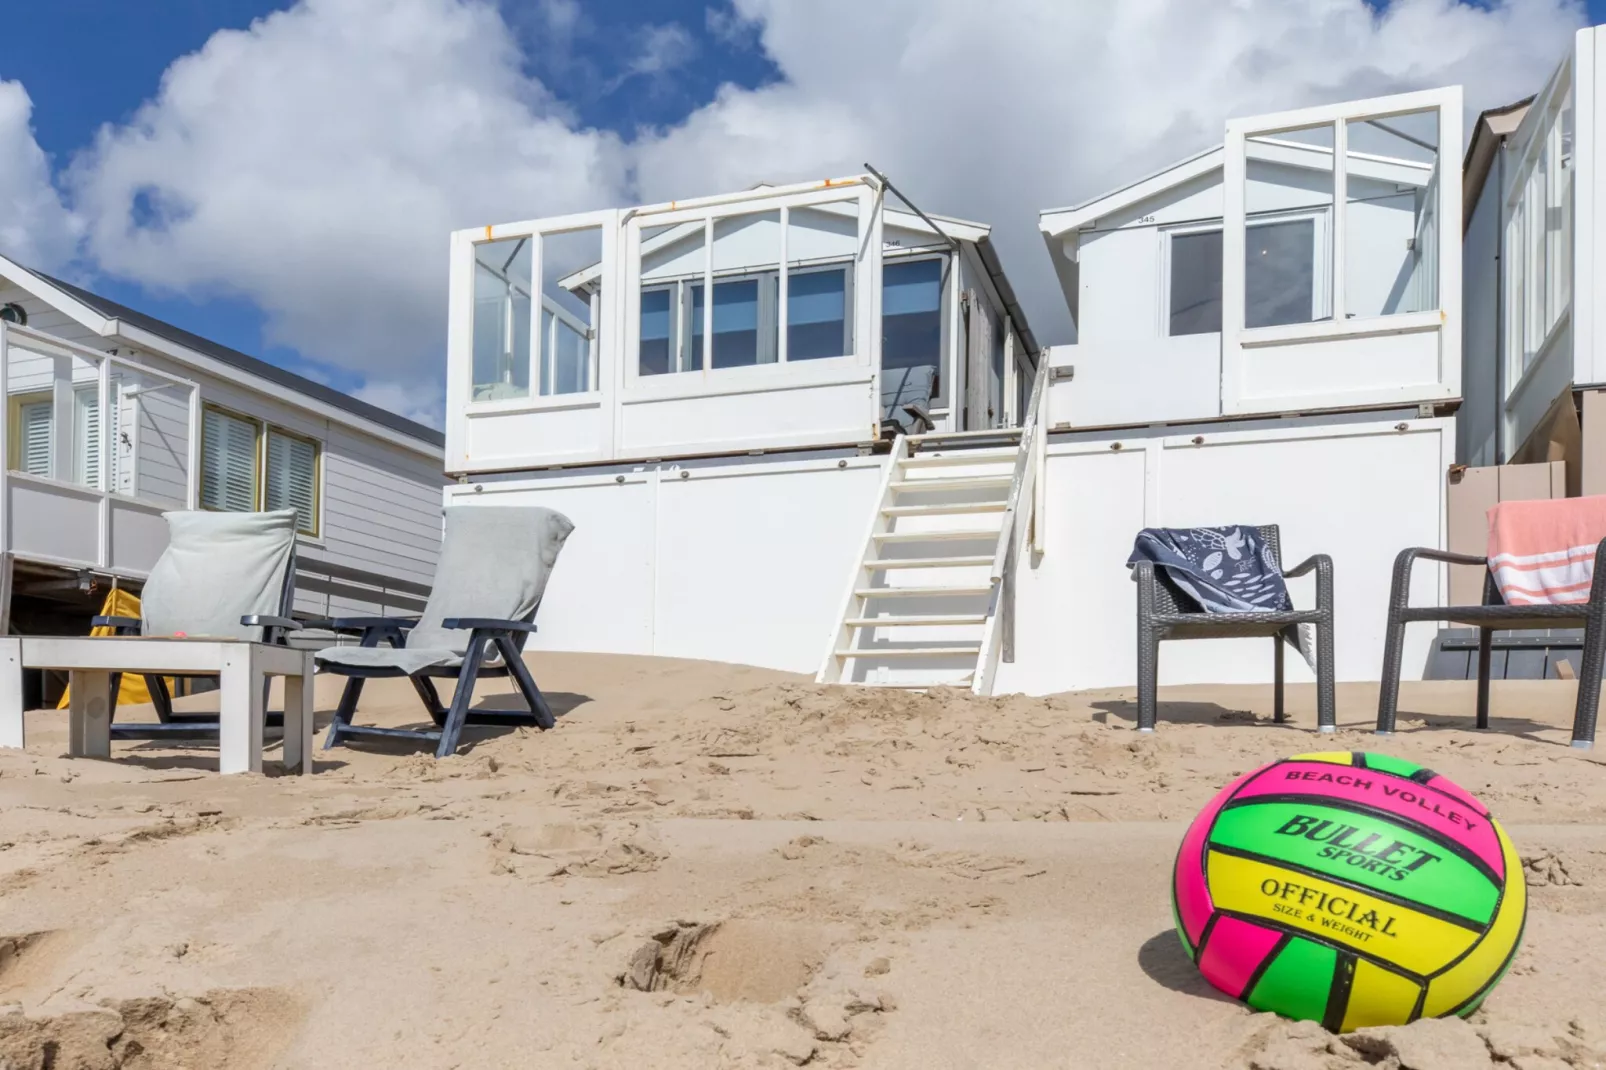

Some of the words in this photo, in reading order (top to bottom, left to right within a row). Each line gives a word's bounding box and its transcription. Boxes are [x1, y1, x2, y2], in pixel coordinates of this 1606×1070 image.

[1138, 215, 1155, 223] 345
[1285, 771, 1372, 790] BEACH
[1383, 785, 1477, 831] VOLLEY
[1274, 814, 1441, 872] BULLET
[1316, 846, 1408, 881] SPORTS
[1260, 878, 1397, 938] OFFICIAL
[1273, 903, 1302, 919] SIZE
[1306, 913, 1316, 923] &
[1321, 917, 1373, 942] WEIGHT
